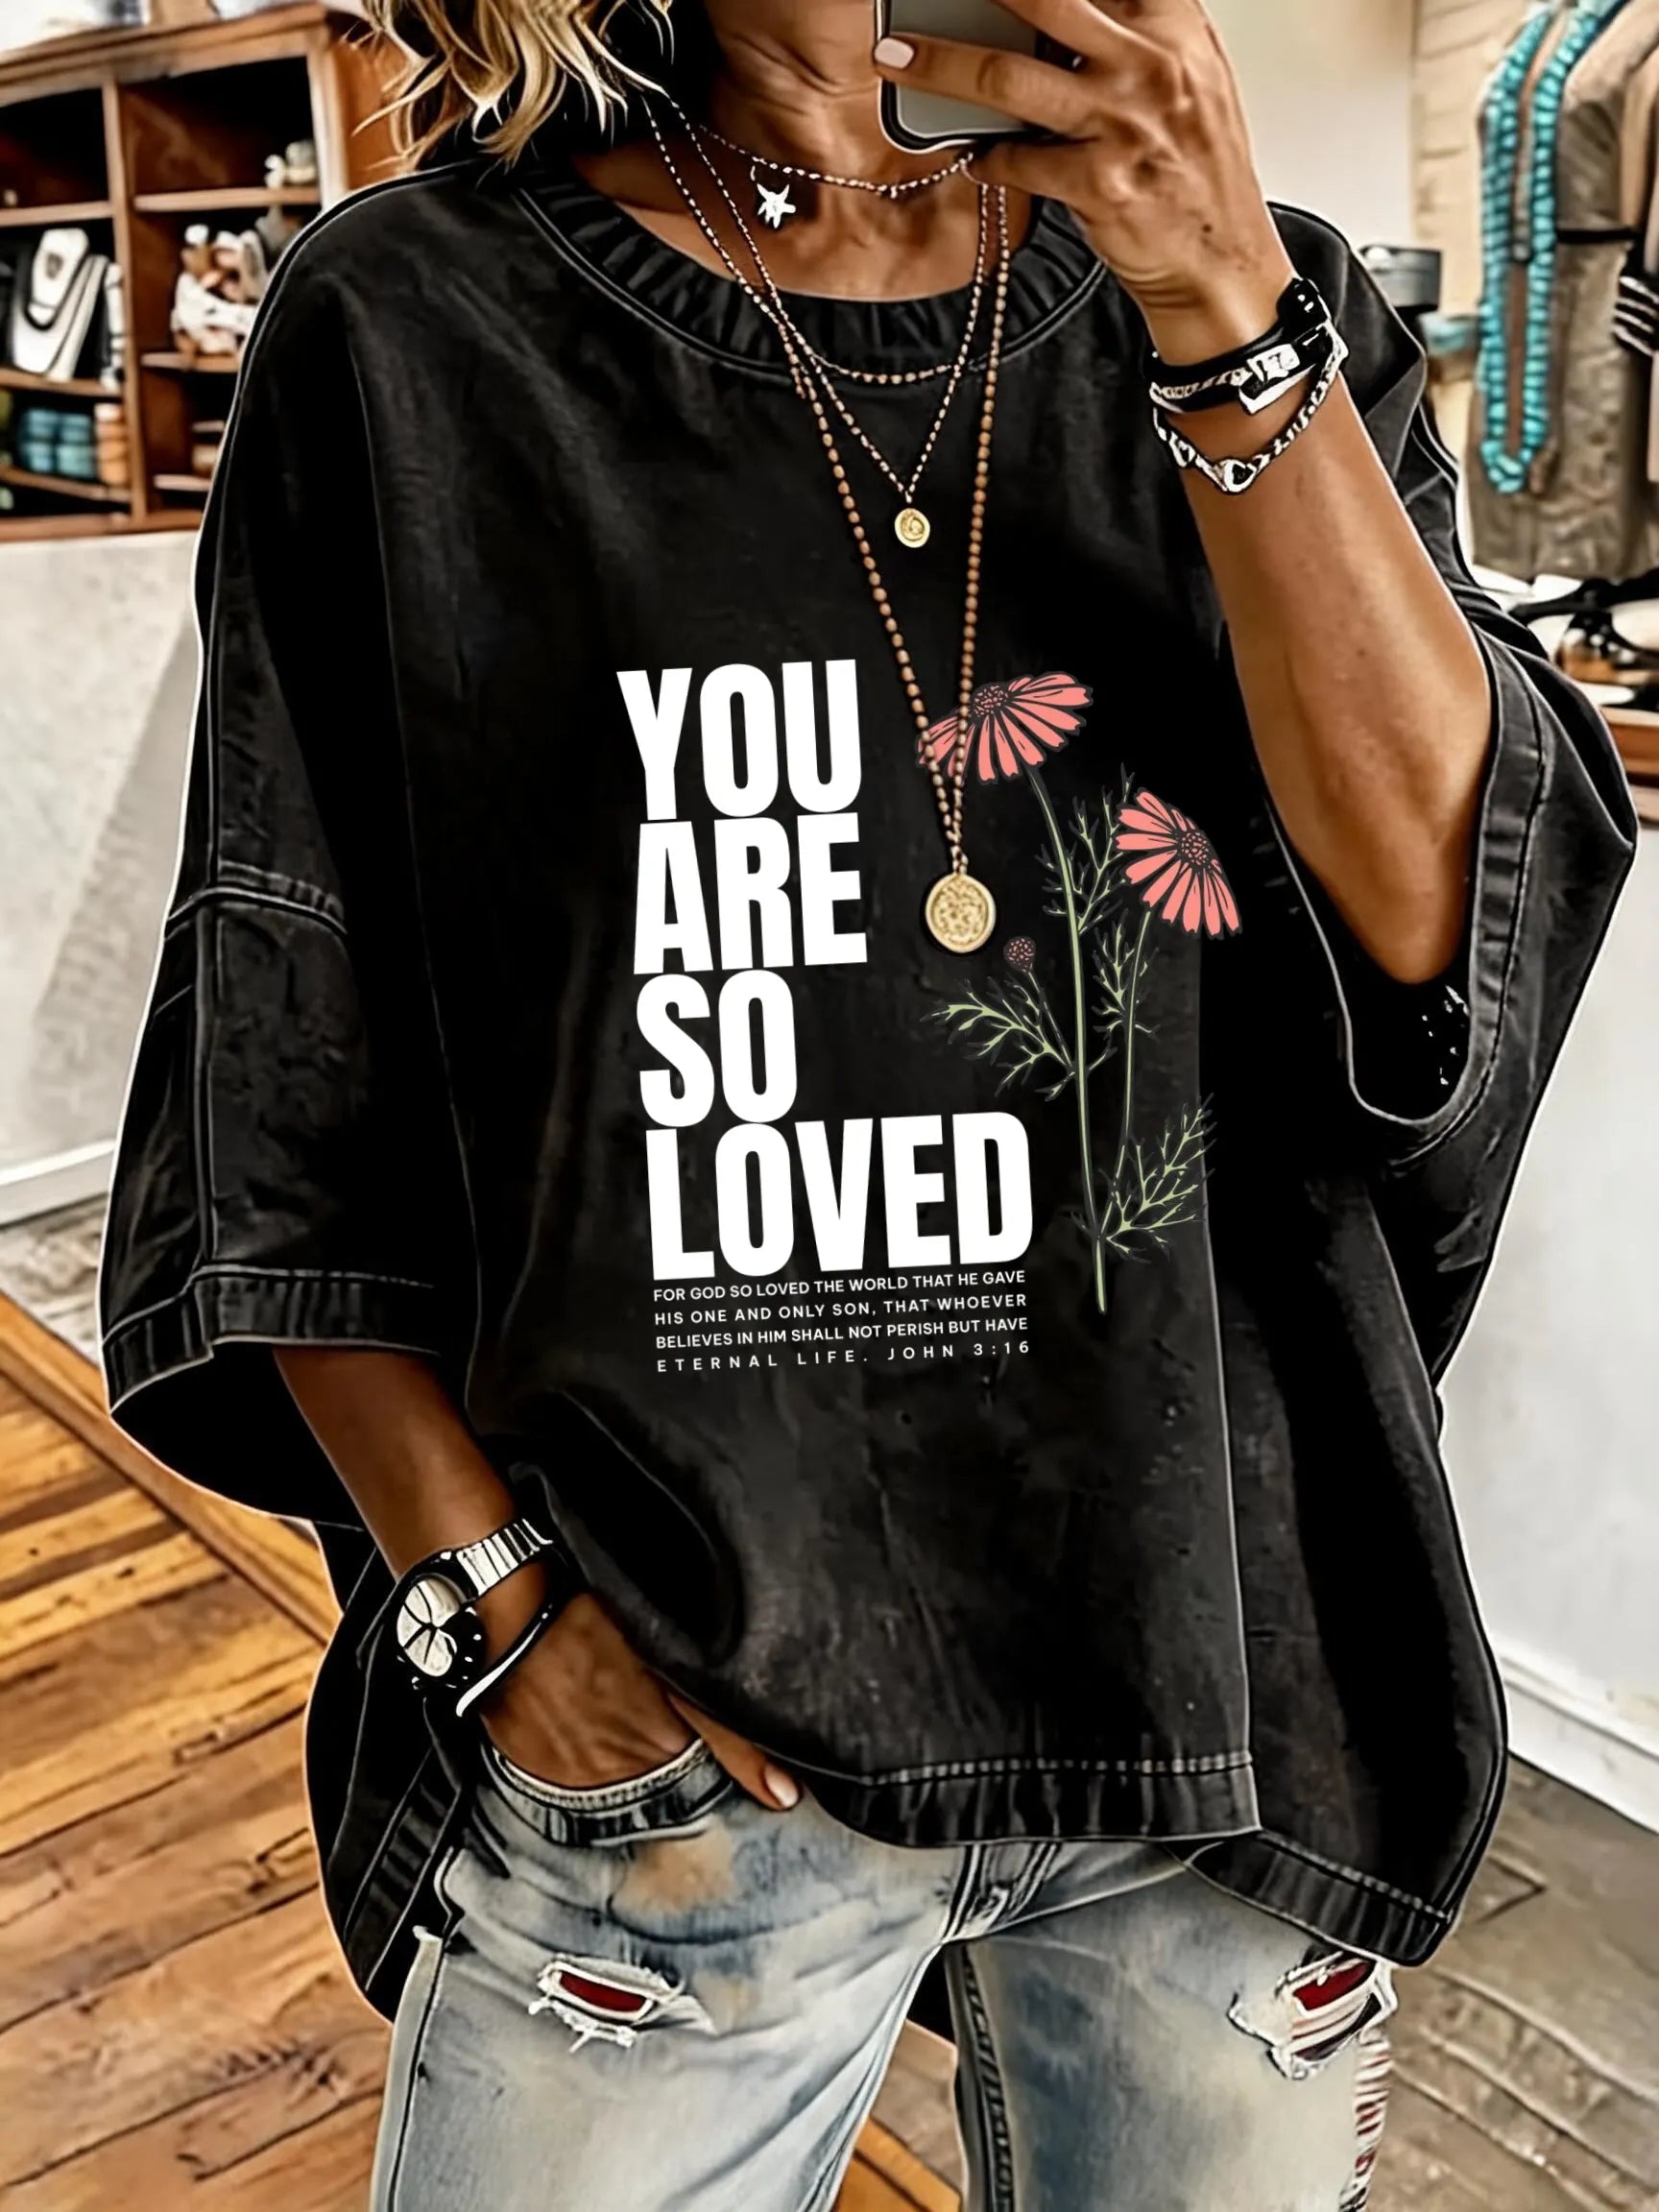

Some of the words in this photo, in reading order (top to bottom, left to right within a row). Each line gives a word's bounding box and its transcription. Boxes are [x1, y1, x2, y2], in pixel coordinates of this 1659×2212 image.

[617, 659, 862, 820] YOU
[633, 812, 867, 974] ARE
[636, 971, 798, 1127] SO
[645, 1111, 1033, 1281] LOVED
[654, 1288, 685, 1302] FOR
[690, 1286, 726, 1300] GOD
[730, 1285, 752, 1298] SO
[757, 1282, 809, 1296] LOVED
[813, 1280, 844, 1293] THE
[849, 1277, 908, 1291] WORLD
[912, 1274, 953, 1287] THAT
[958, 1273, 978, 1286] HE
[982, 1270, 1025, 1285] GAVE
[655, 1311, 684, 1325] HIS
[690, 1310, 727, 1323] ONE
[734, 1308, 771, 1321] AND
[779, 1305, 825, 1318] ONLY
[832, 1302, 876, 1316] SON,
[883, 1299, 929, 1313] THAT
[937, 1294, 1025, 1310] WHOEVER
[656, 1333, 733, 1349] BELIEVES
[737, 1332, 753, 1344] IN
[757, 1330, 786, 1343] HIM
[791, 1328, 844, 1341] SHALL
[849, 1325, 881, 1338] NOT
[887, 1322, 944, 1336] PERISH
[949, 1320, 980, 1334] BUT
[985, 1317, 1027, 1332] HAVE
[658, 1355, 778, 1372] ETERNAL
[798, 1350, 867, 1365] LIFE.
[888, 1345, 953, 1360] JOHN
[974, 1341, 1028, 1356] 3:16
